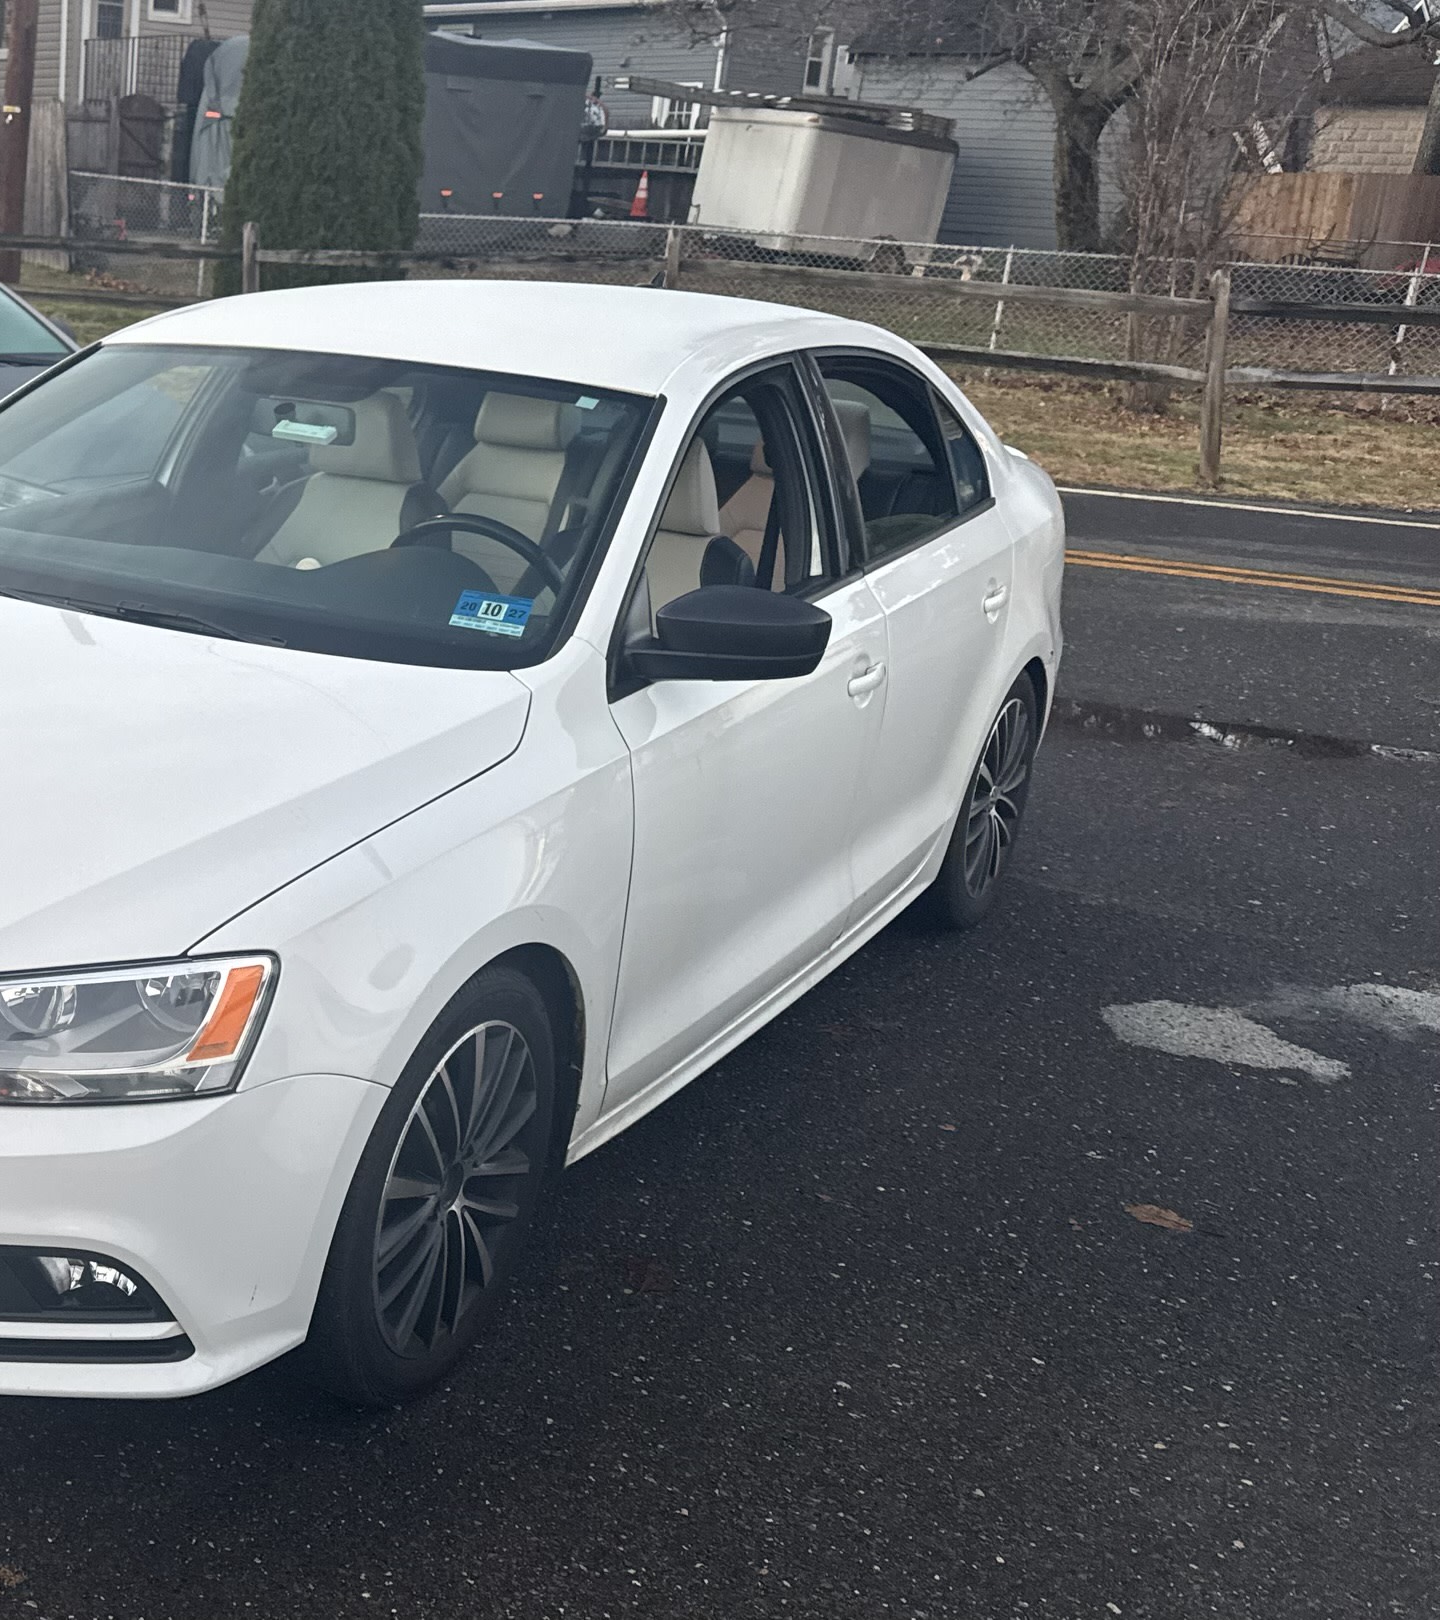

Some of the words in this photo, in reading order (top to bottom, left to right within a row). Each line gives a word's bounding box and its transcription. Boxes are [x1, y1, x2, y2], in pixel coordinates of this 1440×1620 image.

[461, 601, 477, 611] 20
[481, 602, 502, 617] 10
[508, 609, 527, 619] 27
